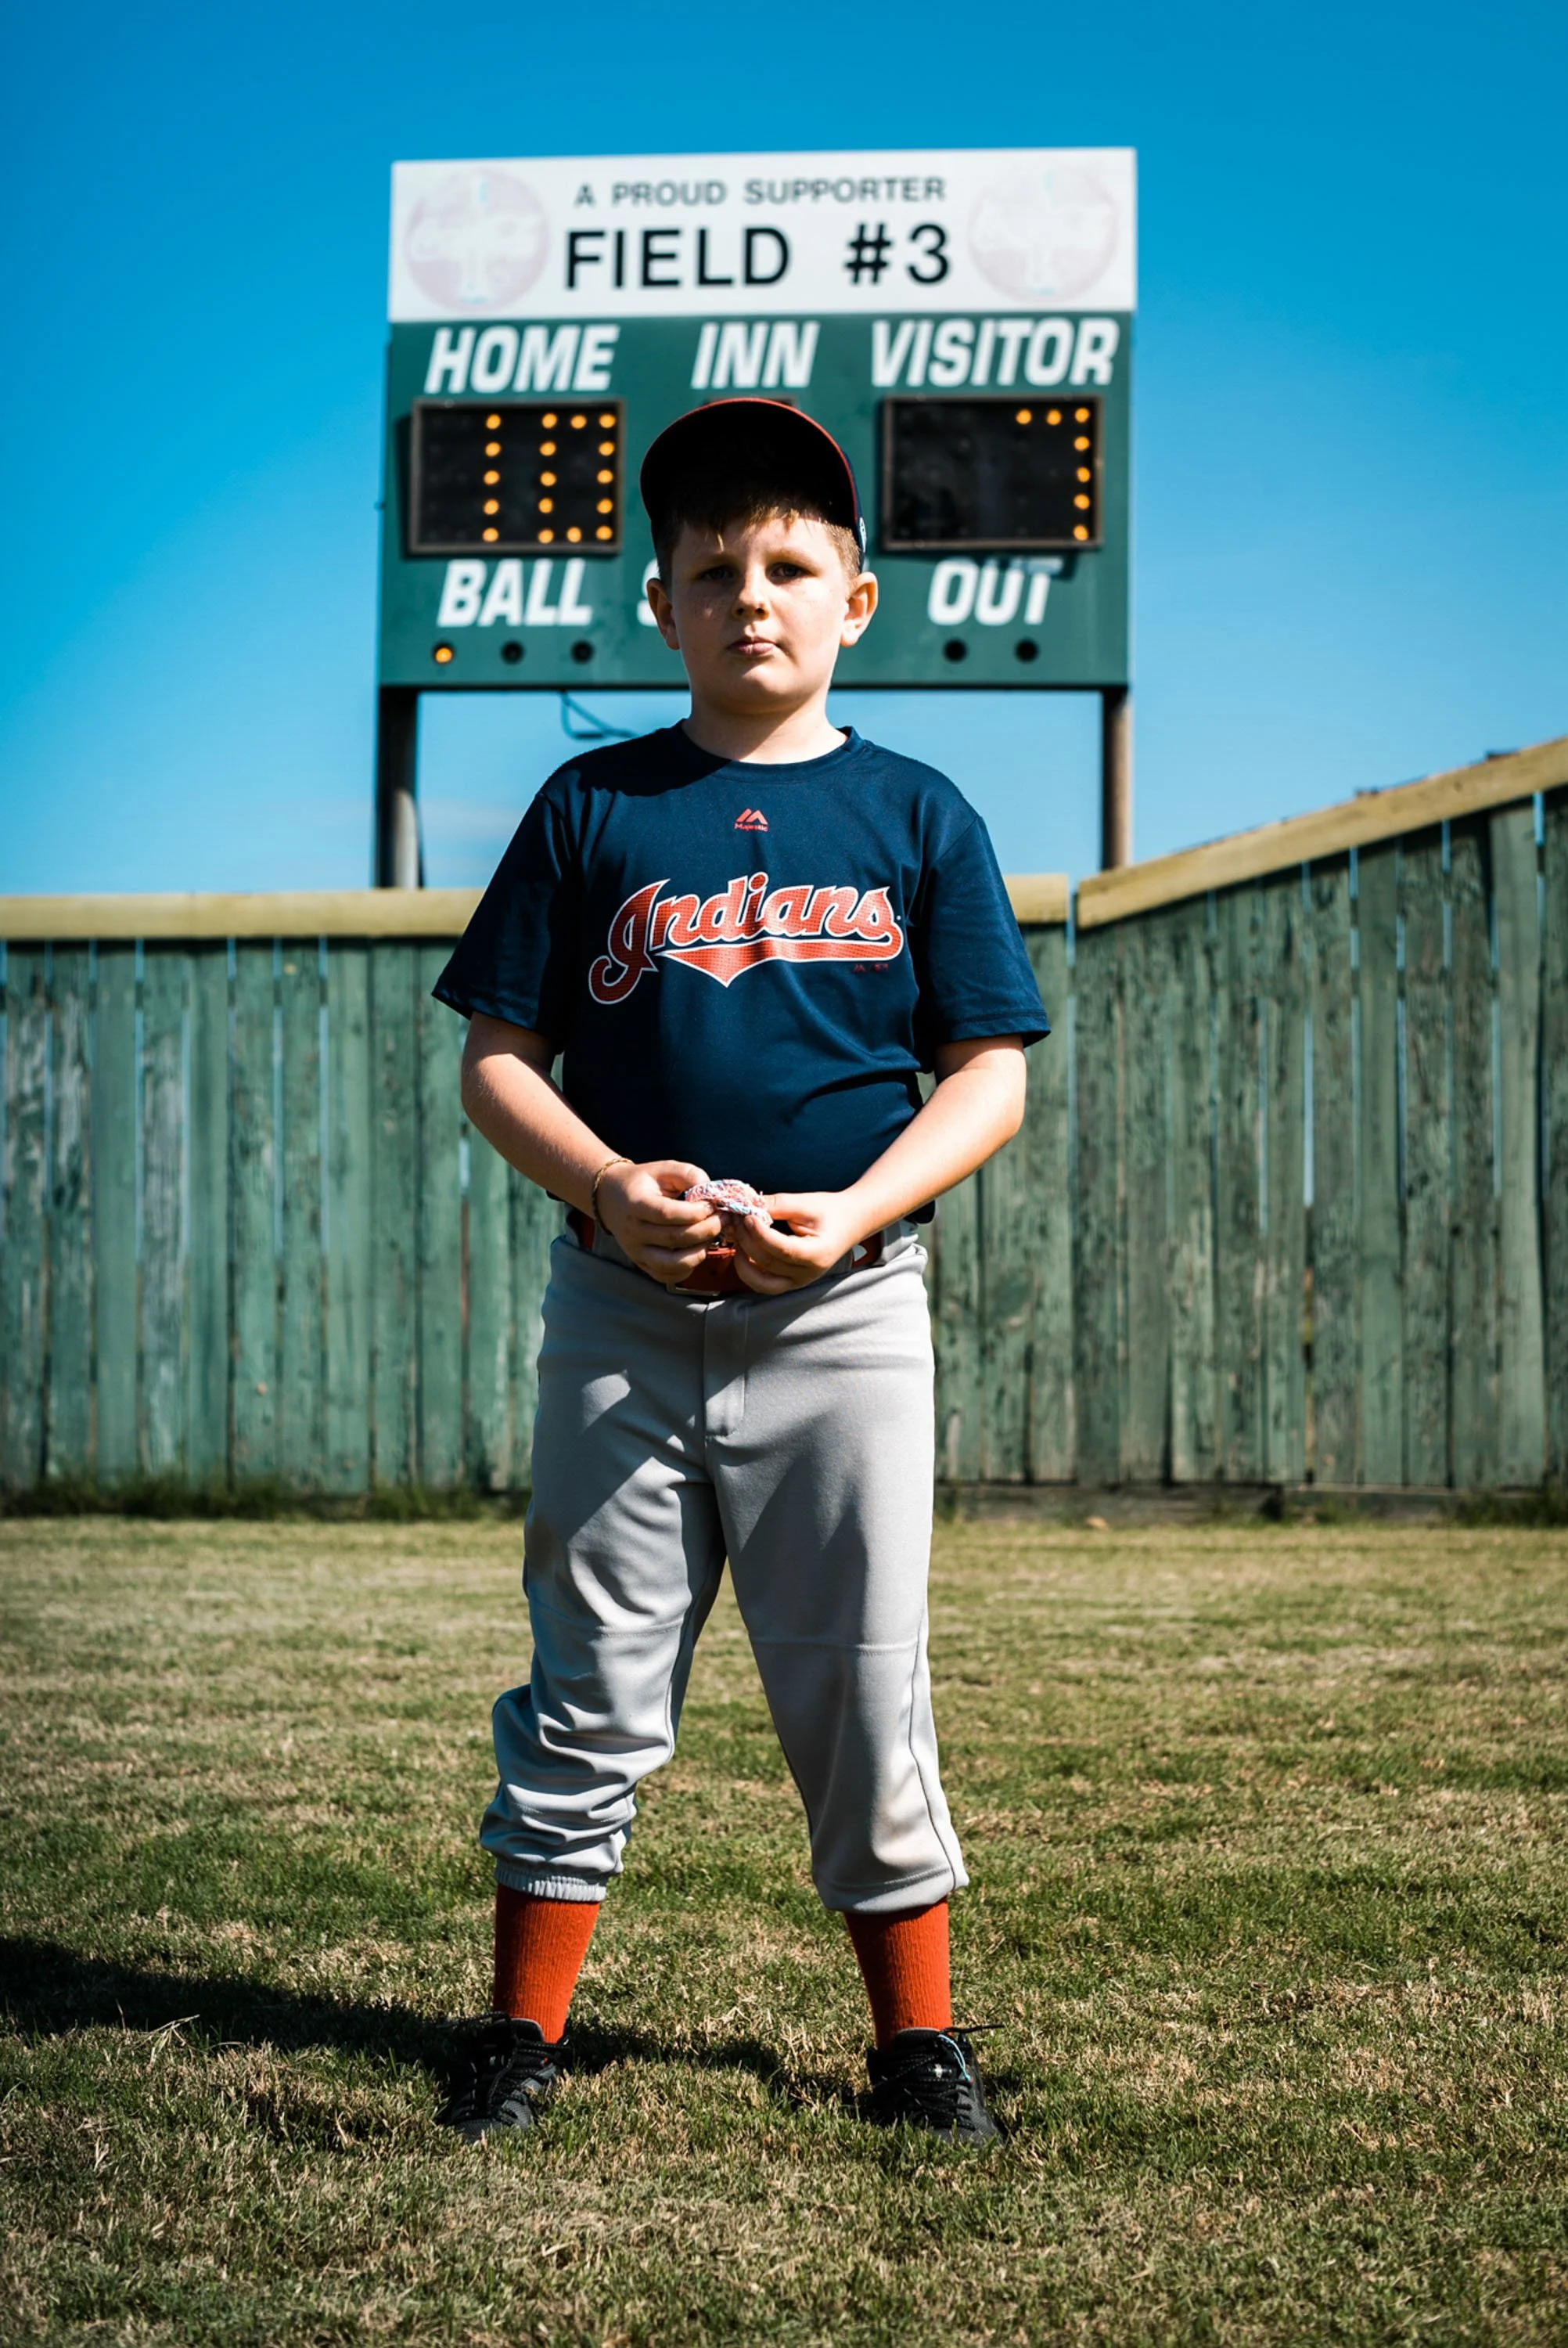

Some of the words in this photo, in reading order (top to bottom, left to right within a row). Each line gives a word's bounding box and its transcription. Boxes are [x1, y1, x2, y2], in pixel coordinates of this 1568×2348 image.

[574, 183, 595, 207] A
[612, 180, 728, 207] PROUD
[744, 177, 946, 205] SUPPORTER
[566, 226, 790, 290] FIELD
[844, 223, 951, 286] #3
[425, 325, 619, 394] HOME
[692, 322, 819, 389] INN
[872, 318, 1119, 387] VISITOR
[1016, 408, 1091, 542] 7
[437, 559, 592, 627] BALL
[928, 559, 1061, 626] OUT
[588, 872, 903, 1005] Indians
